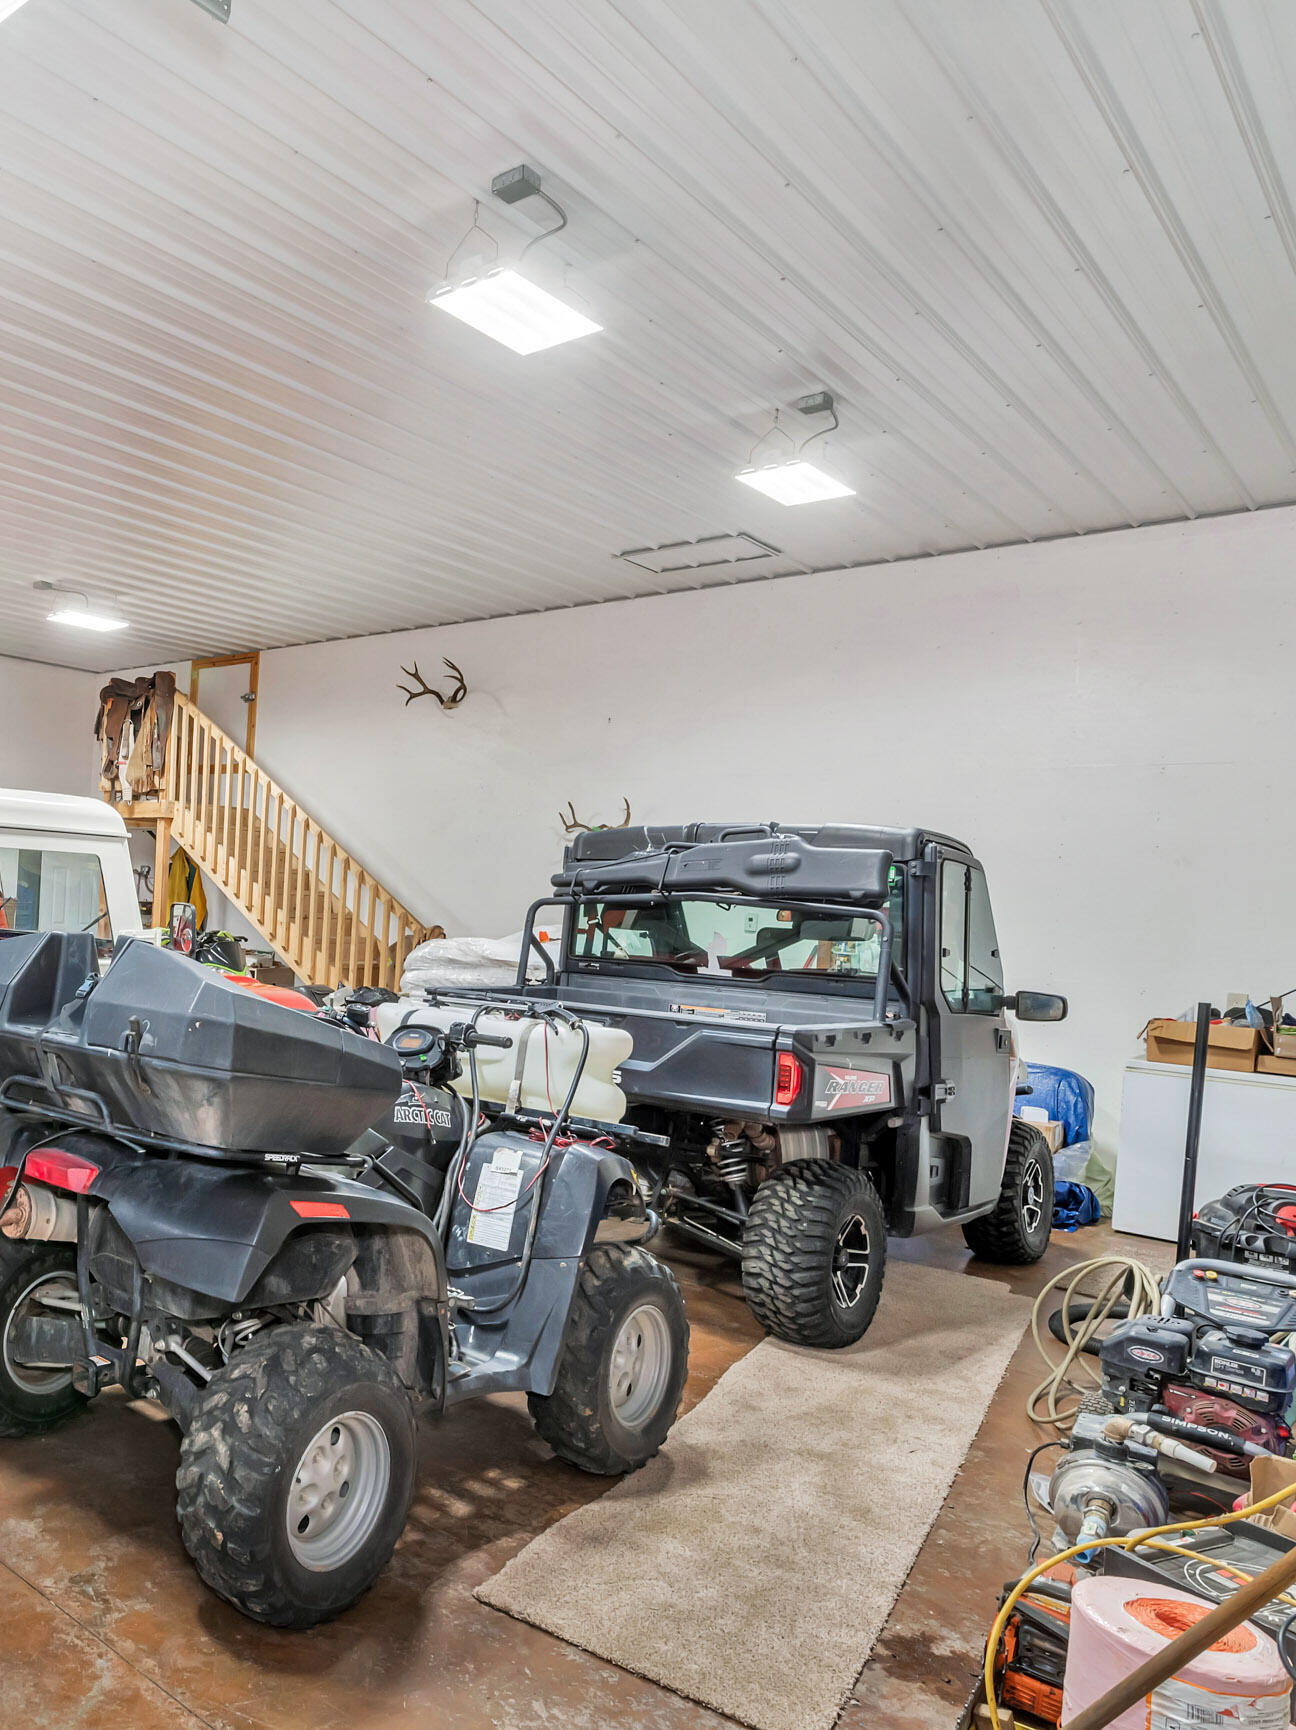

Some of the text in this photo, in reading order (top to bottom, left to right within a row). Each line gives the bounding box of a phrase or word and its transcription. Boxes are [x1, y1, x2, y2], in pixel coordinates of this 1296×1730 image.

[825, 1079, 885, 1096] RANGER
[394, 1106, 452, 1128] ARCTIC CAT
